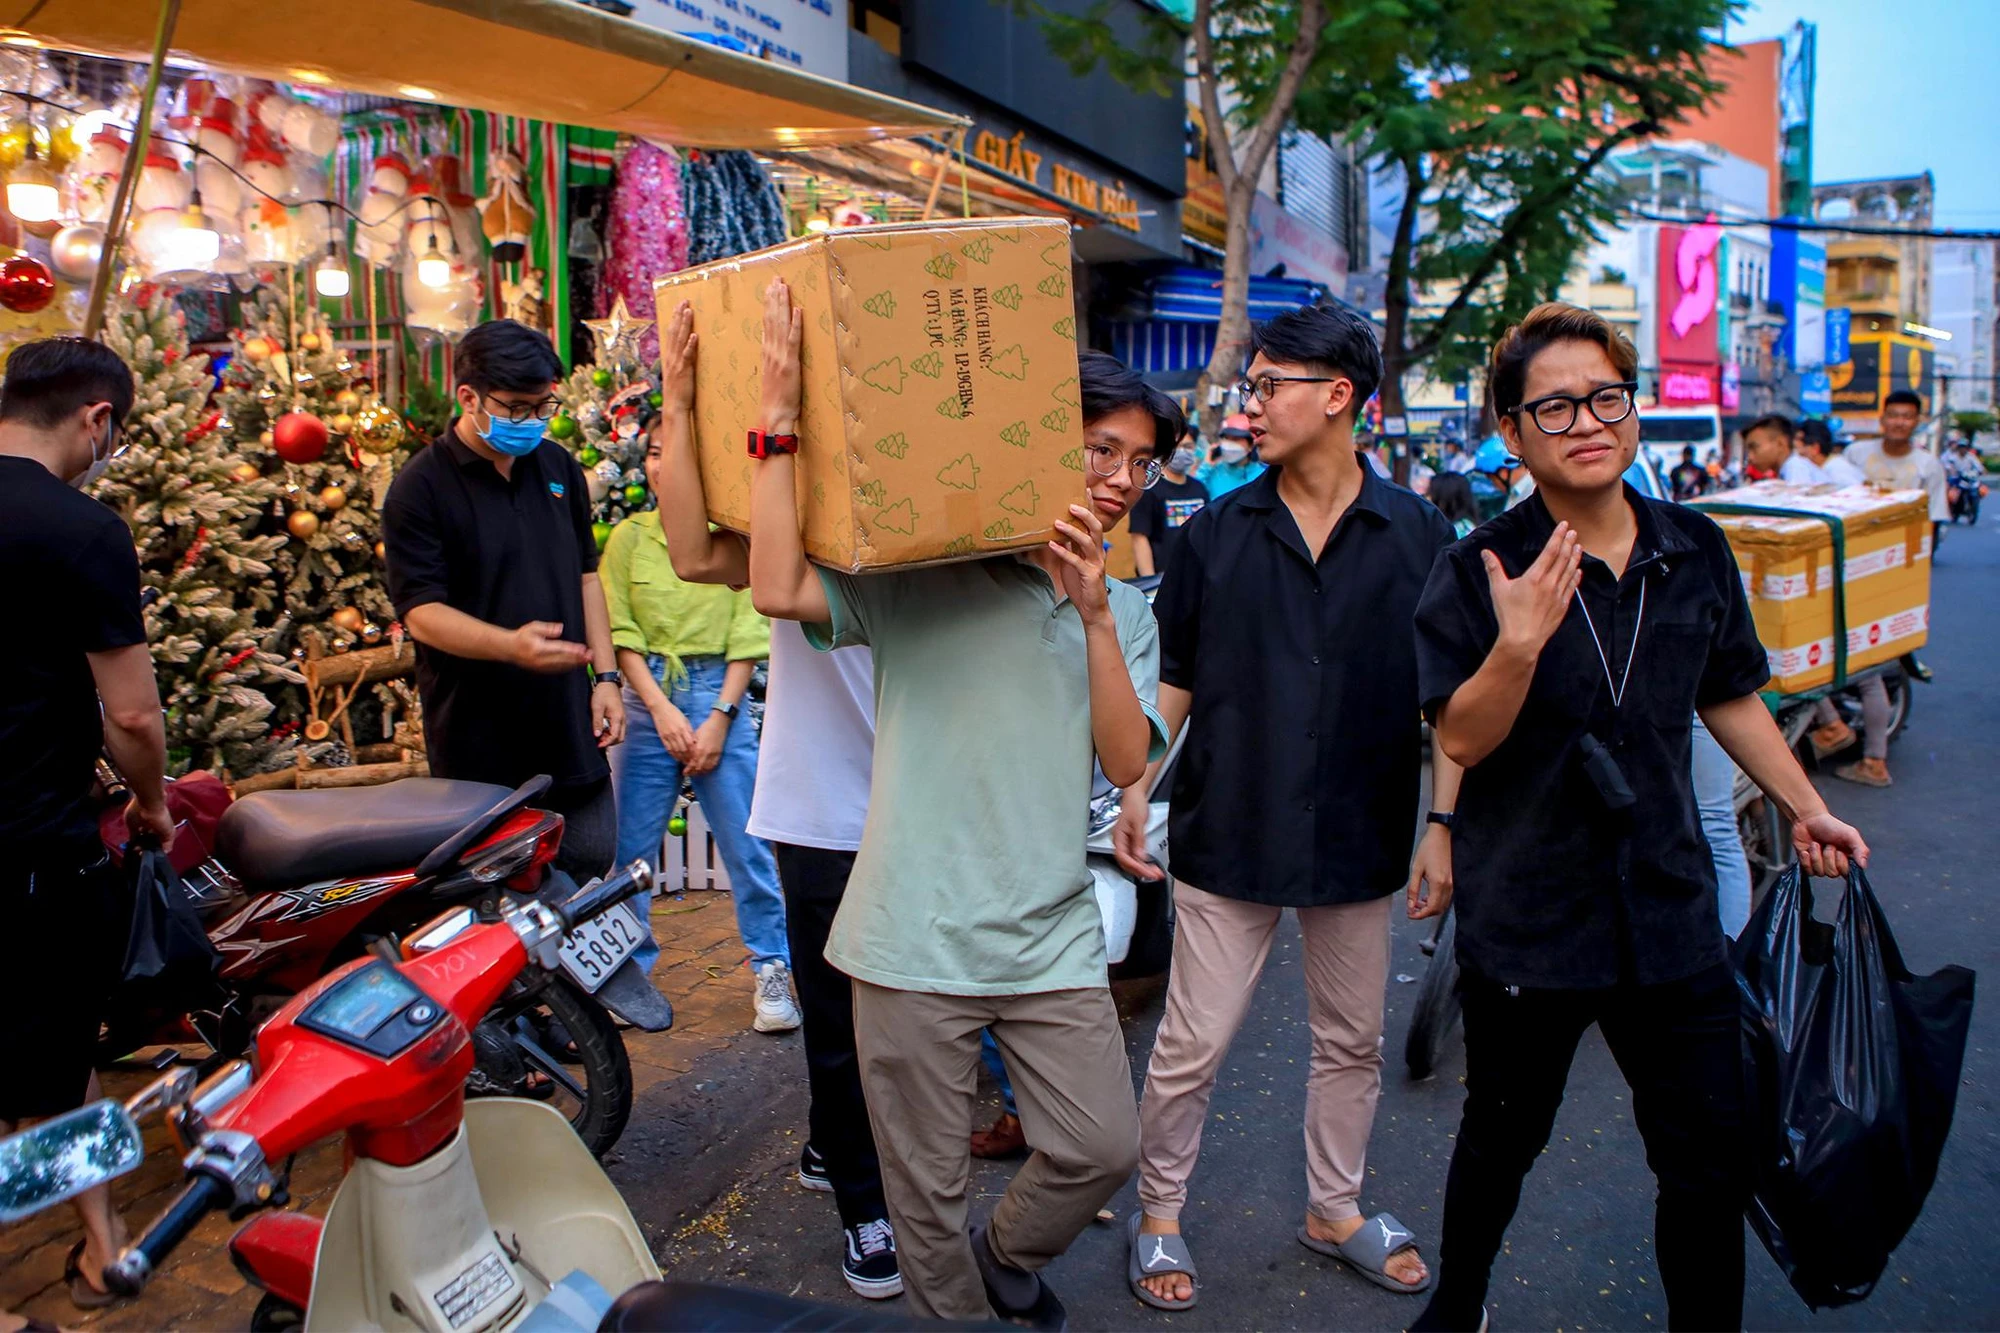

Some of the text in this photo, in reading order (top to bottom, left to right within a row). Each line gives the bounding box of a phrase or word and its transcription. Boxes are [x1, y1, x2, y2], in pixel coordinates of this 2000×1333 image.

[1052, 163, 1098, 212] KIM
[973, 287, 992, 328] KHÁCH
[574, 918, 637, 979] 5892
